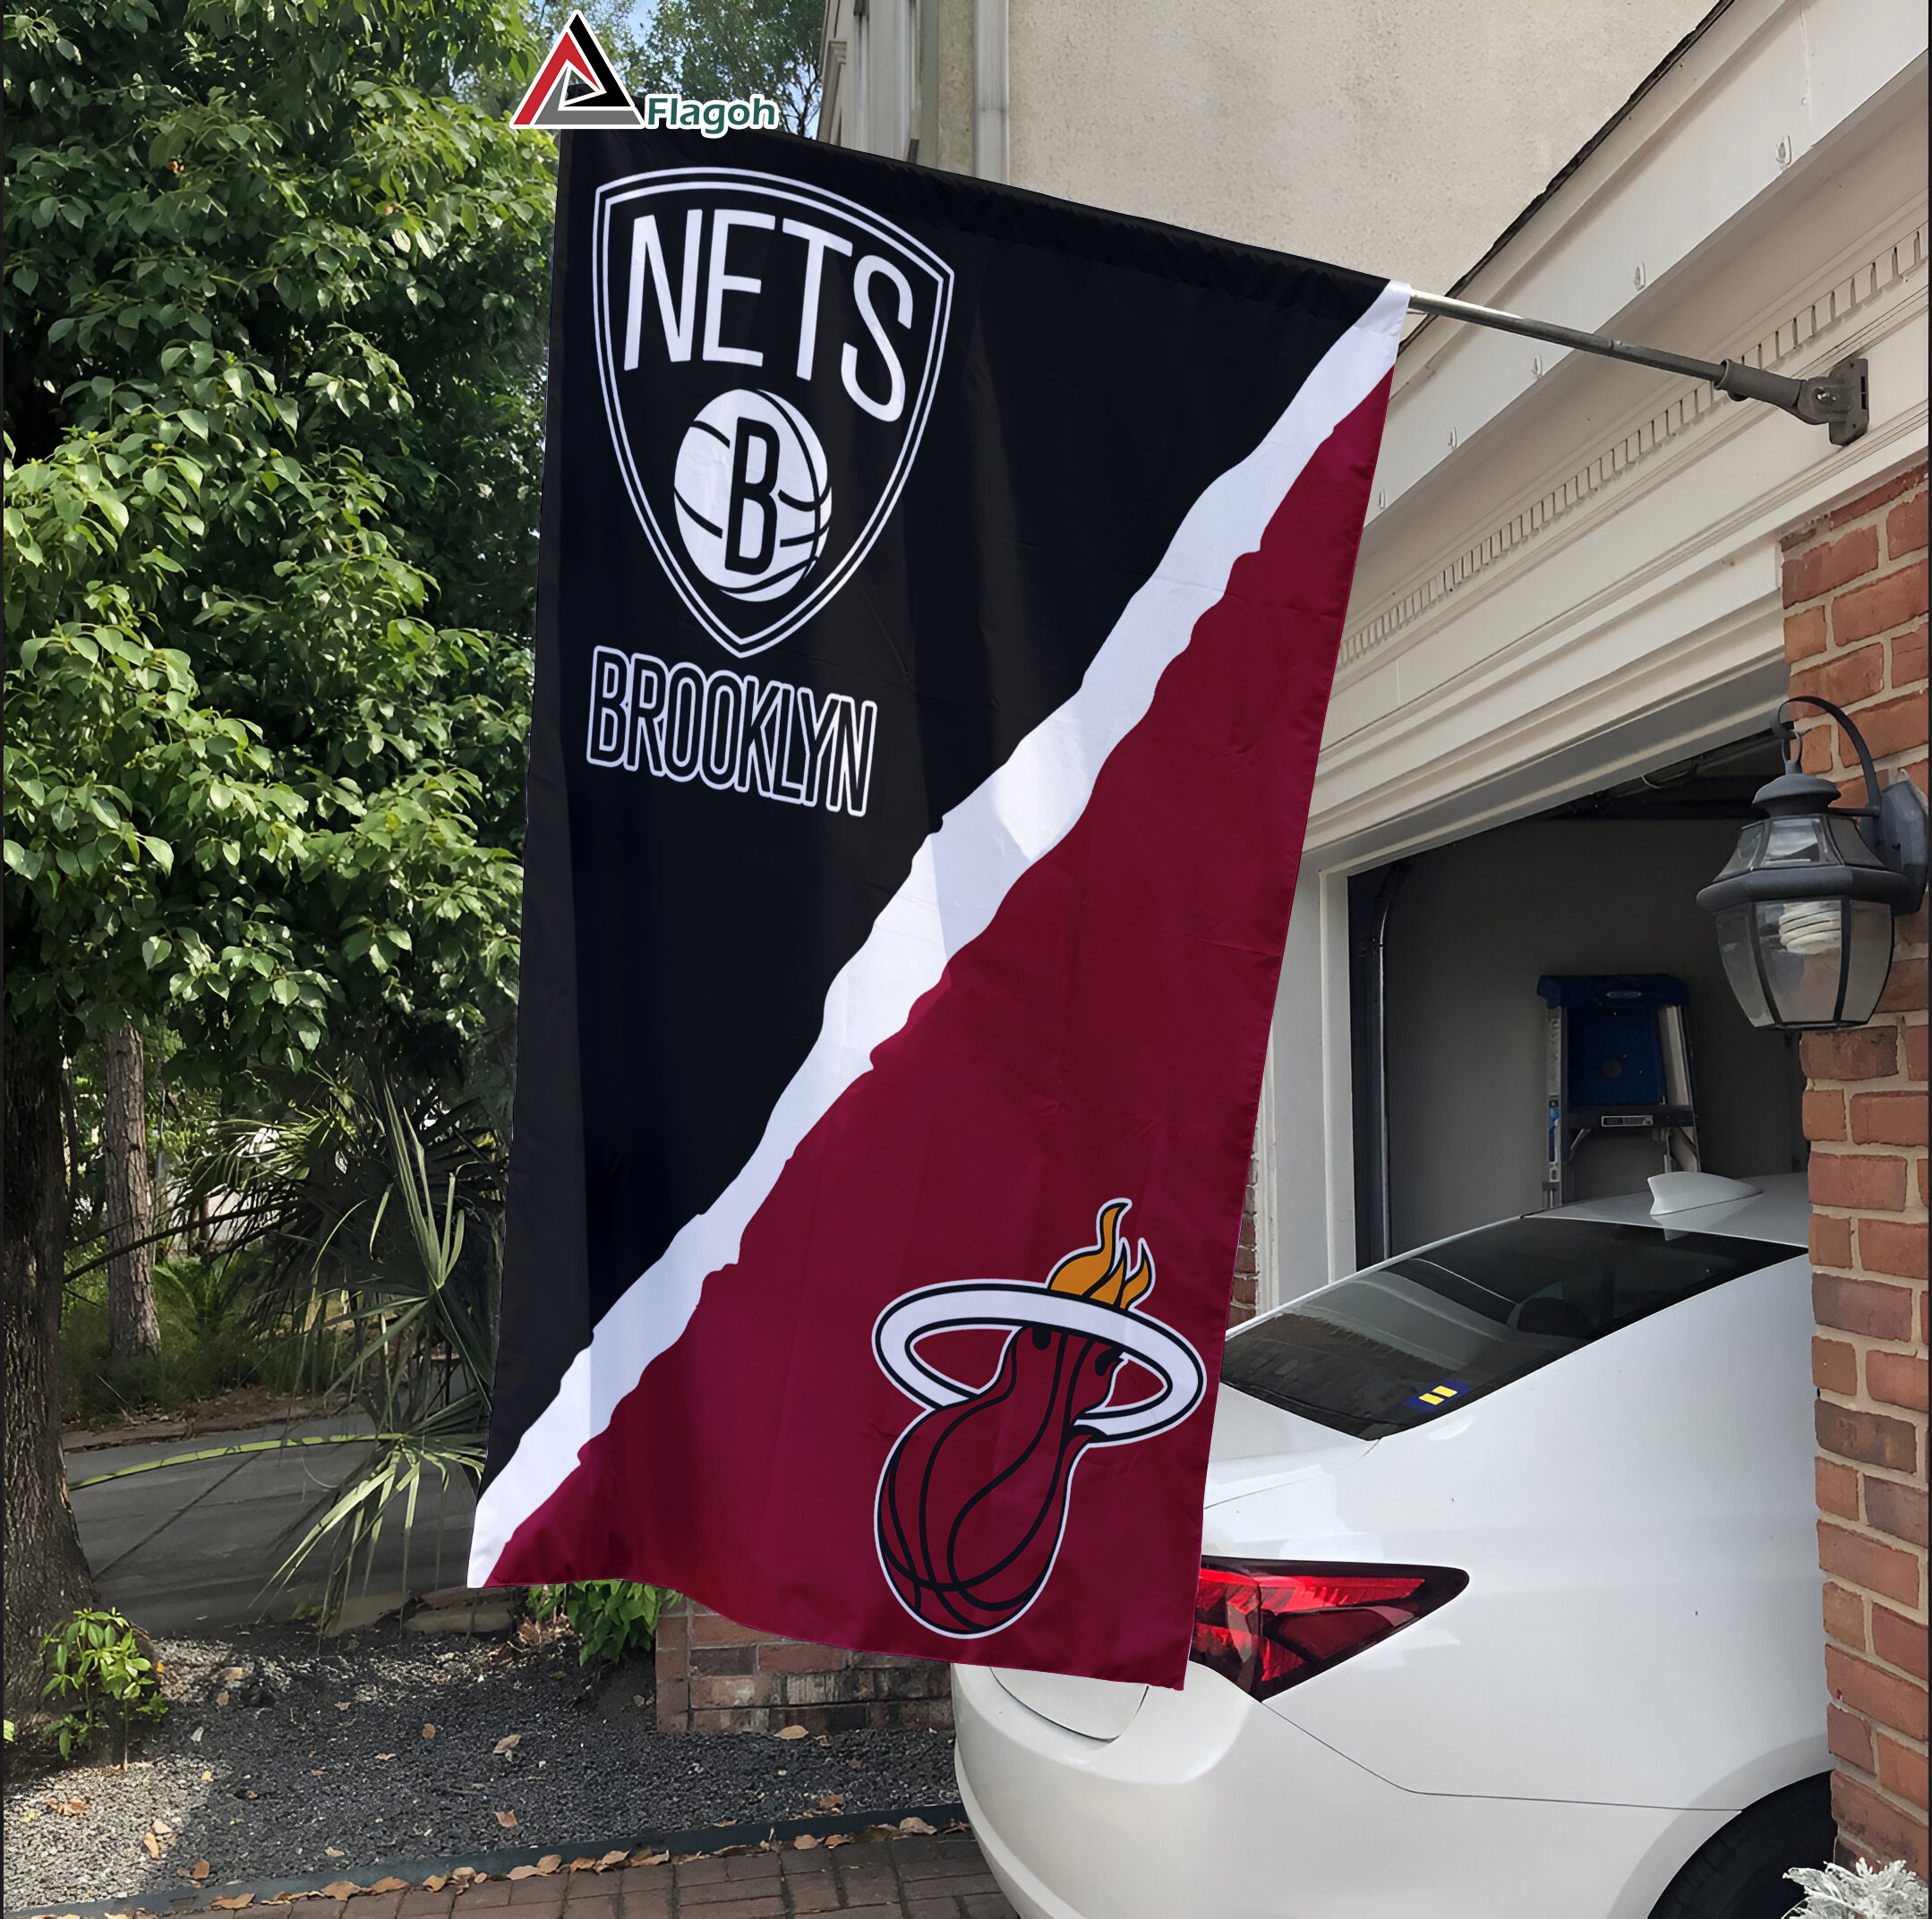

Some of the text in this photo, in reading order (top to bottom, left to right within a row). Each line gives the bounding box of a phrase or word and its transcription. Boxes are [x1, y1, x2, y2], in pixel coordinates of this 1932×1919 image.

[624, 209, 913, 422] NETS
[724, 416, 781, 576] B
[586, 645, 877, 817] BROOKLYN
